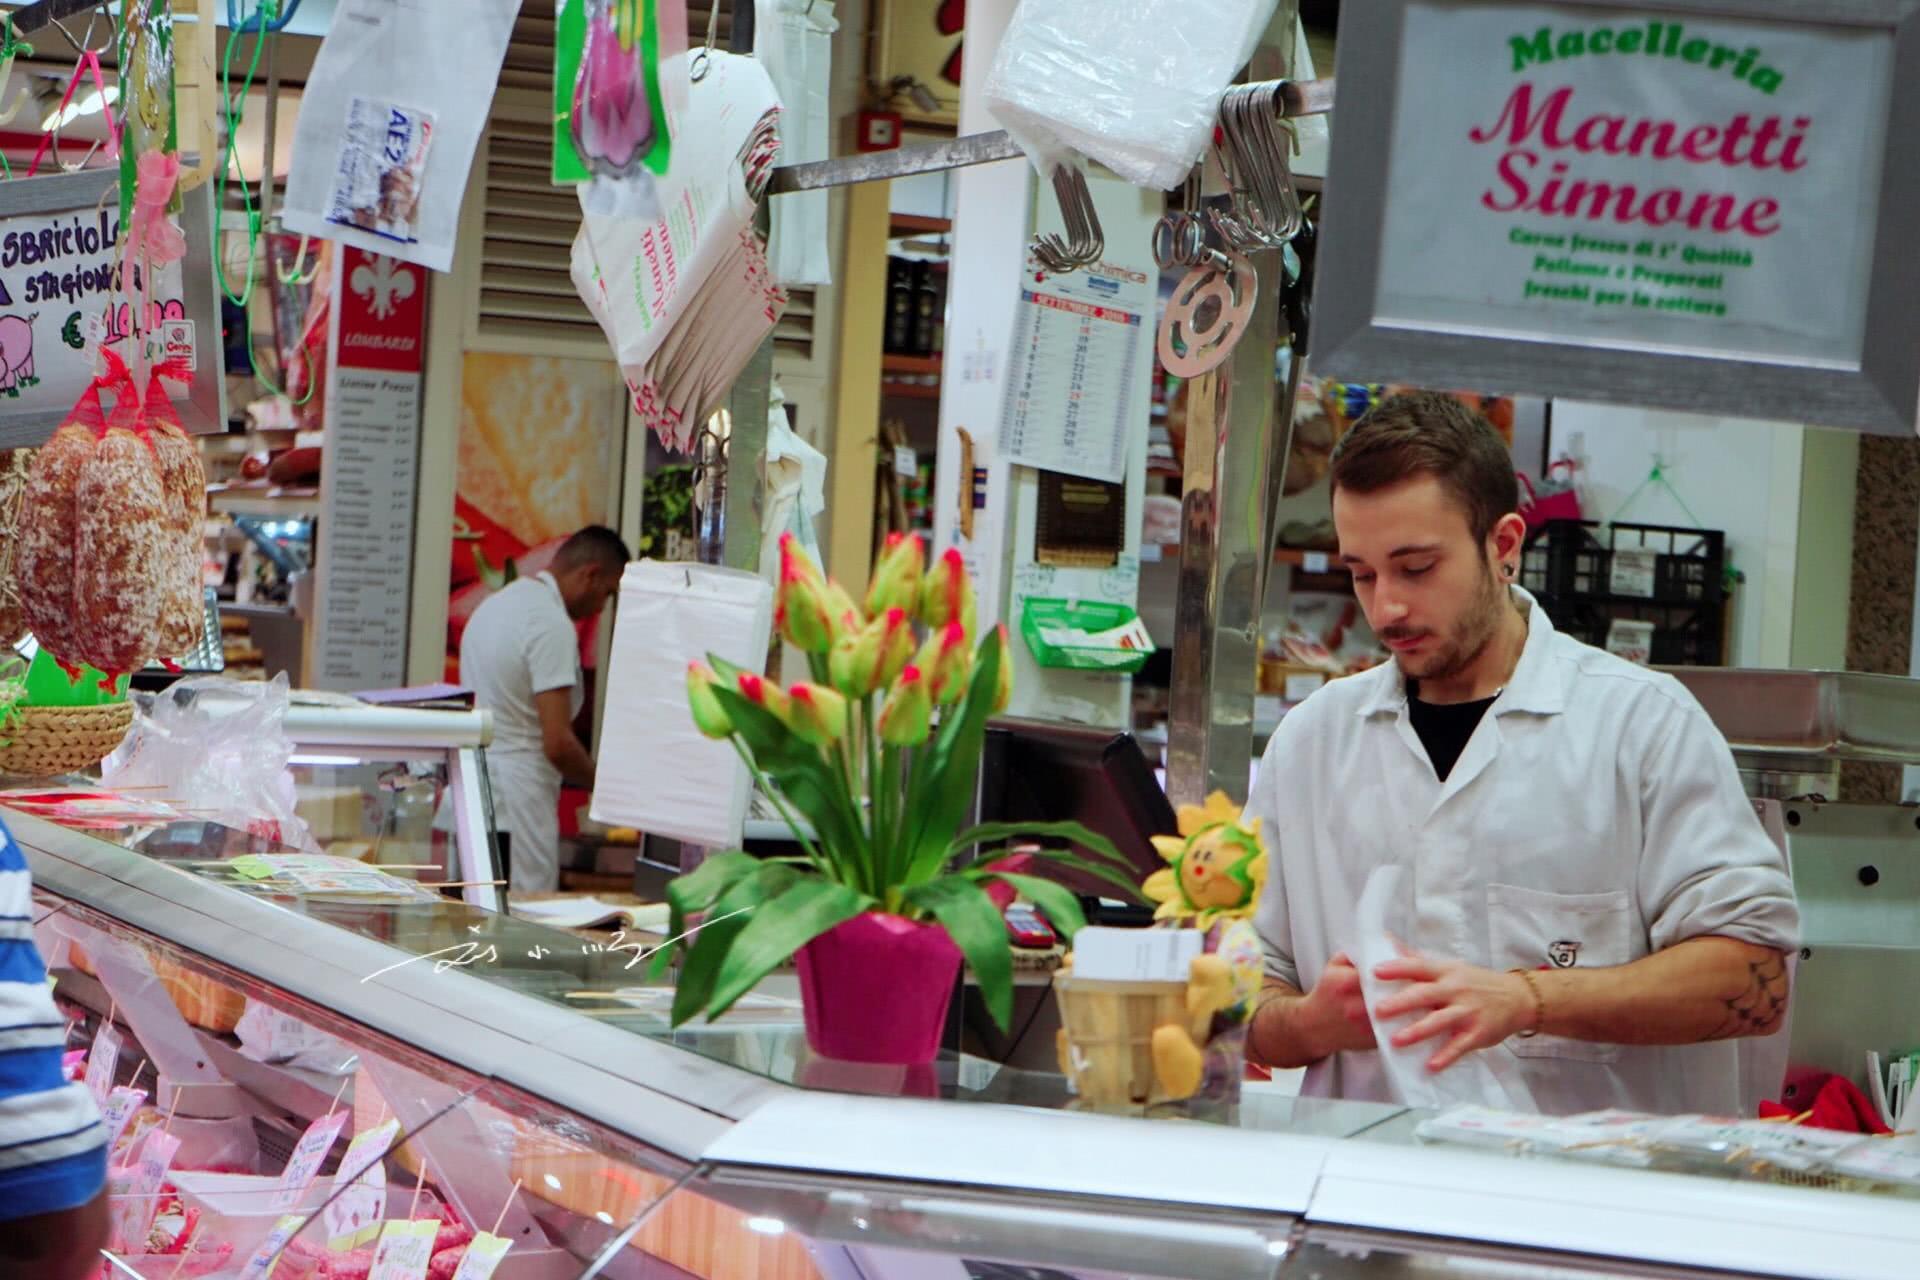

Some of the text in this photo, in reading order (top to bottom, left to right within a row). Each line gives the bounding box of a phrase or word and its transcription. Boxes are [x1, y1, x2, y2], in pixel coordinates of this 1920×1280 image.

[1508, 20, 1784, 95] Macelleria
[1468, 81, 1812, 173] Manetti
[1481, 150, 1781, 236] Simone
[343, 332, 416, 352] LOMBARDI
